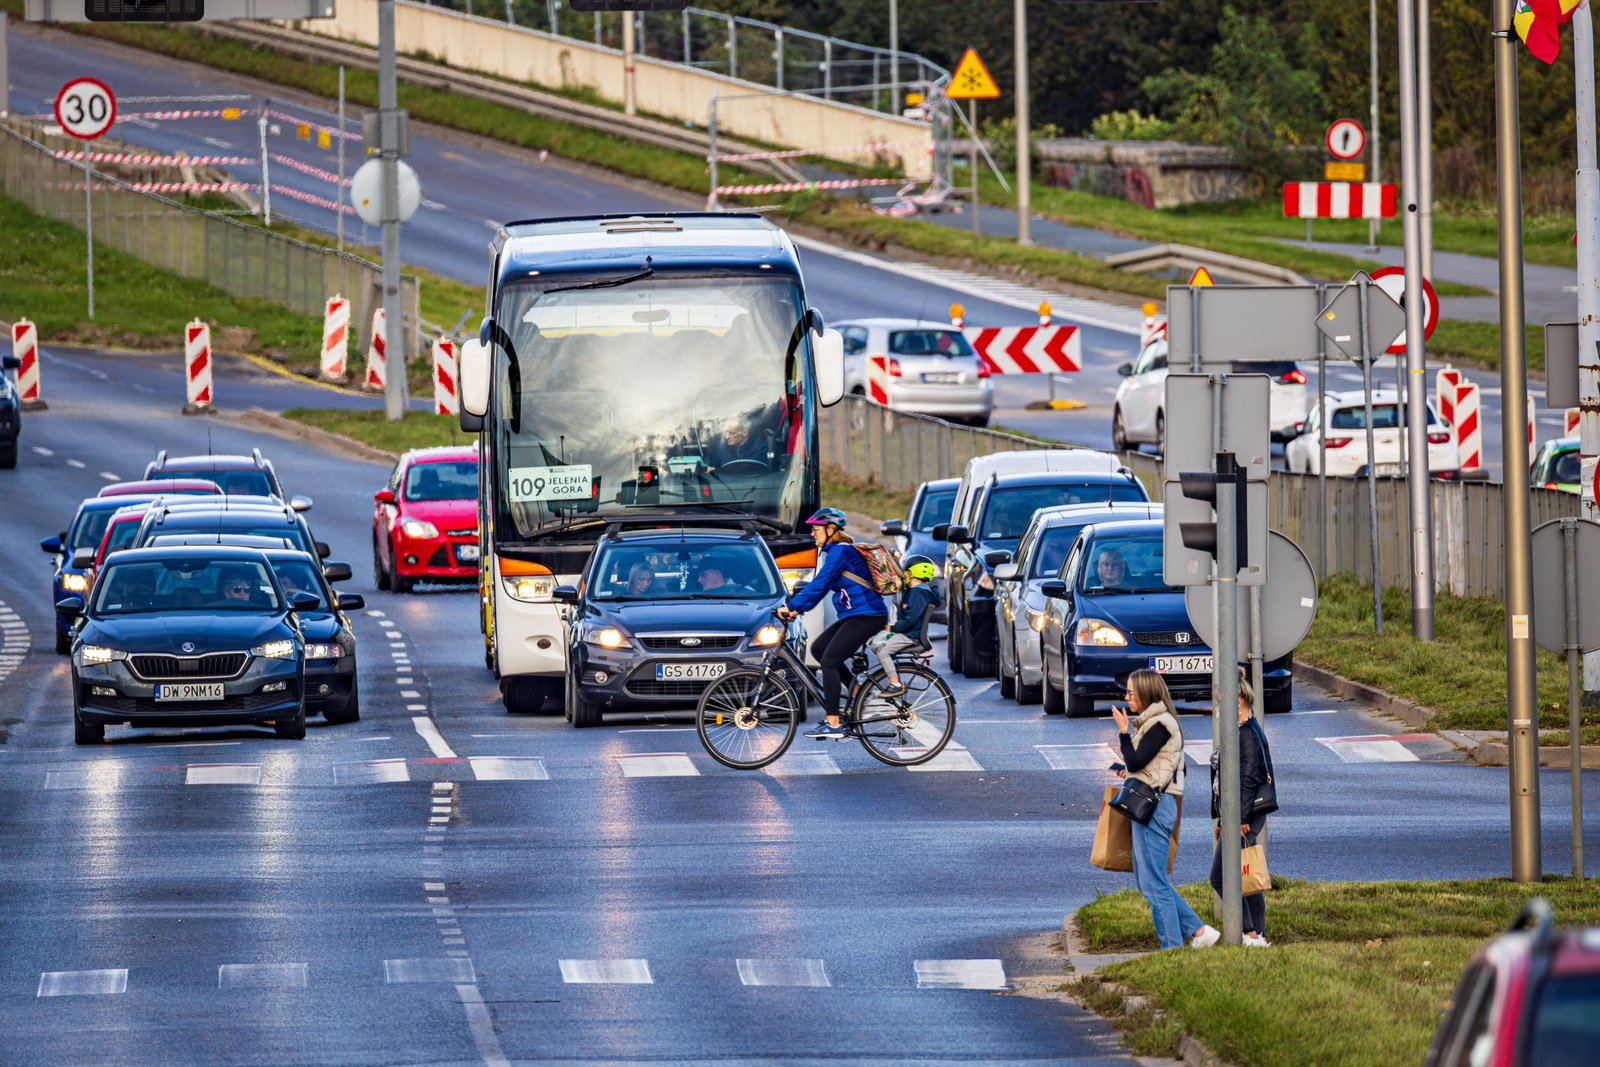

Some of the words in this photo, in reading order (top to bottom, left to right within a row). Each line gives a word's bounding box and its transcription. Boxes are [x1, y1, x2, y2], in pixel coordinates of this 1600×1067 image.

[67, 94, 107, 124] 30
[512, 478, 545, 497] 109
[548, 476, 588, 485] JELENIA
[664, 665, 682, 678] GS
[686, 665, 724, 677] 61769
[163, 686, 179, 698] DW
[183, 684, 221, 698] 9NM16
